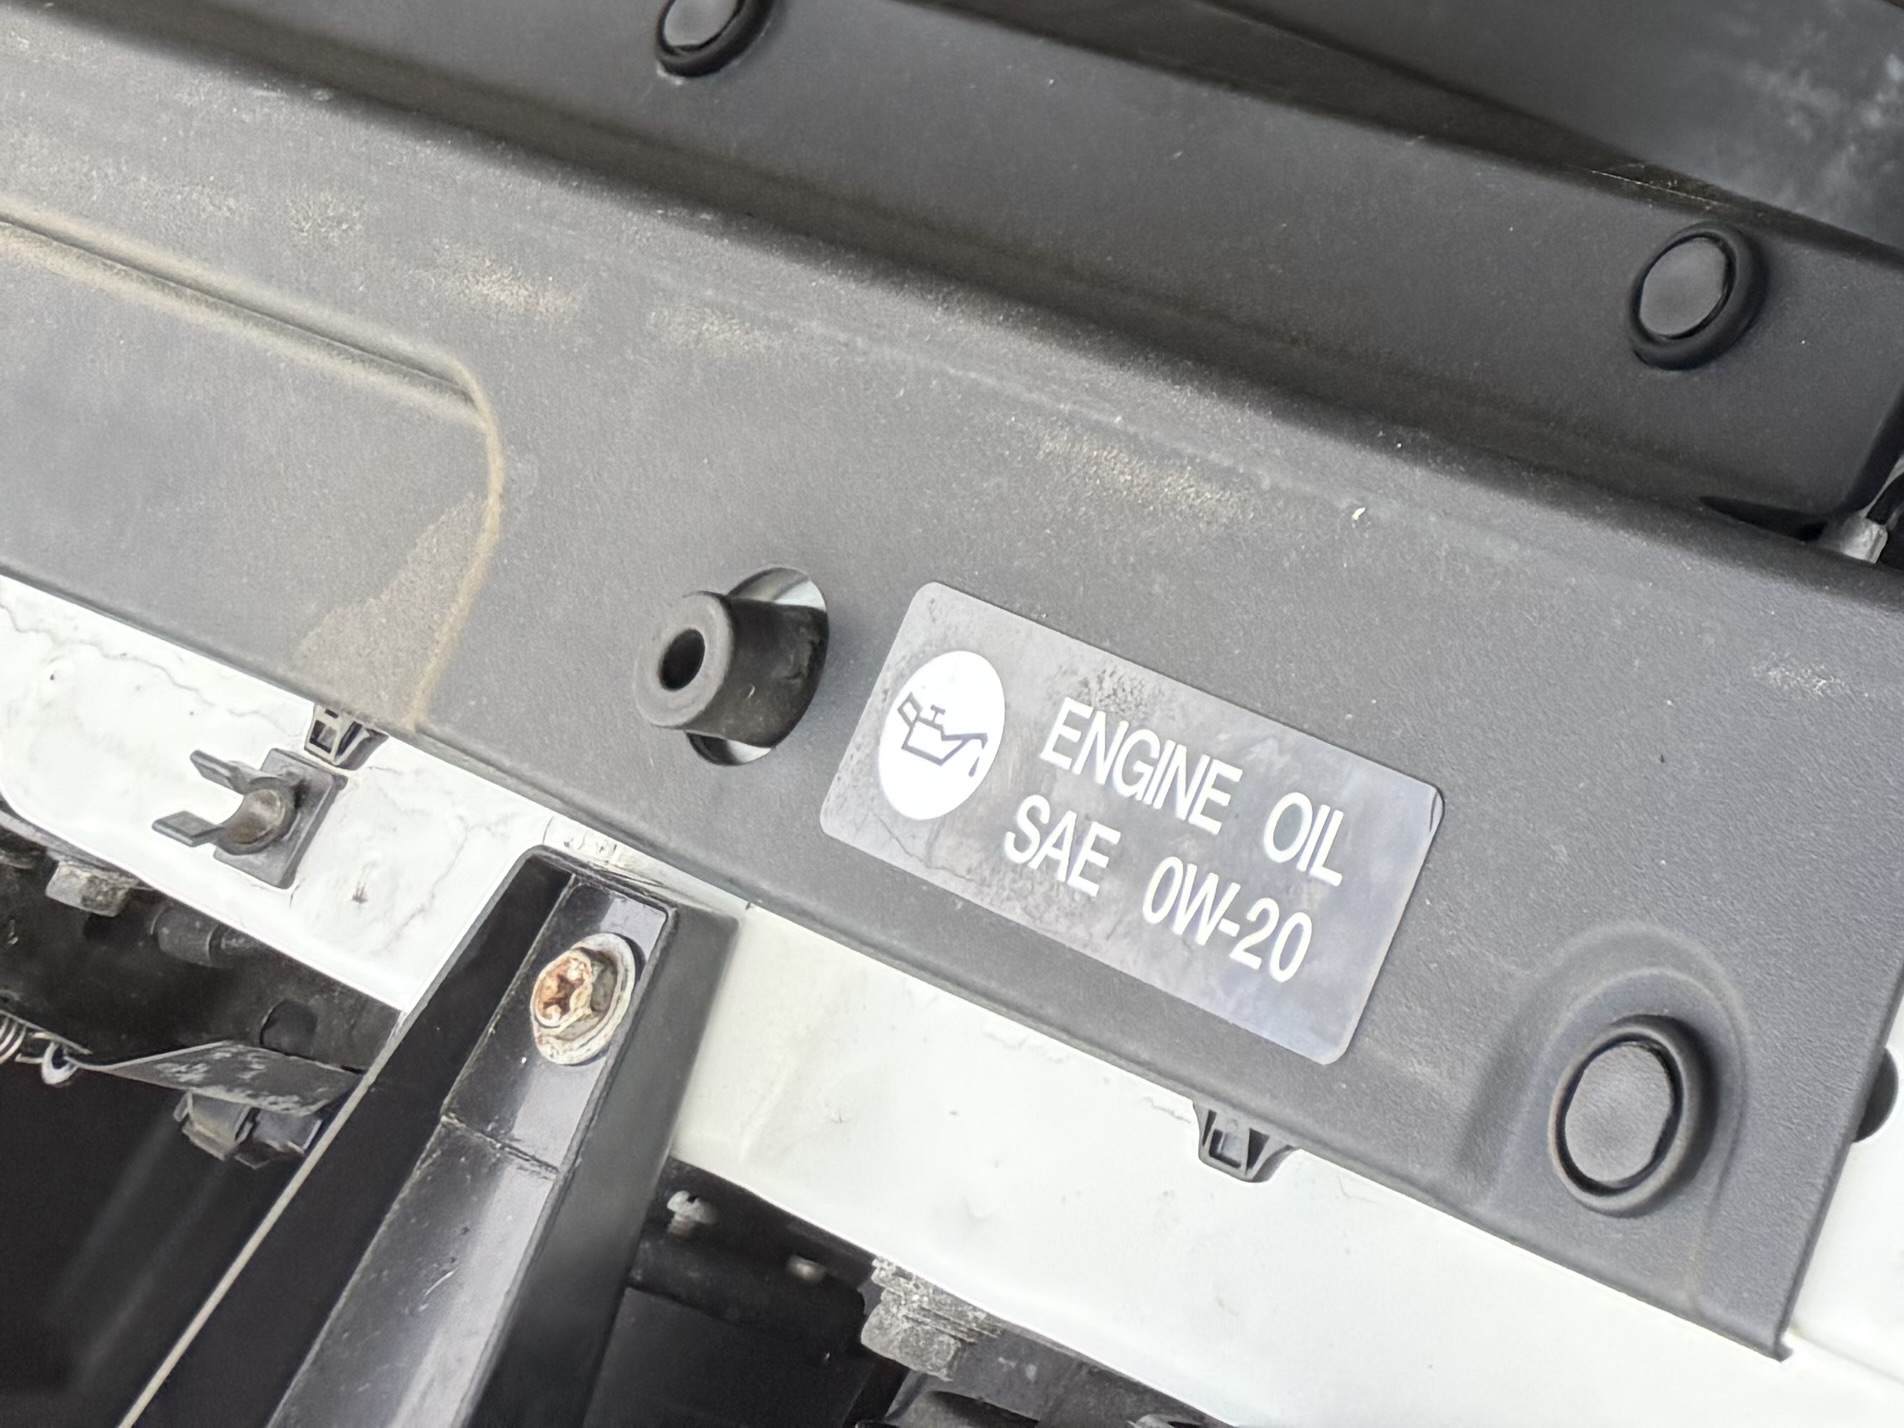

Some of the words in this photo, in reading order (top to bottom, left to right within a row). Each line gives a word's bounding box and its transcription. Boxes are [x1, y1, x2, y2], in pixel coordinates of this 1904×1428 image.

[1038, 696, 1244, 835] ENGINE
[1262, 792, 1344, 887] OIL
[1004, 794, 1121, 897] SAE
[1140, 856, 1313, 982] 0W-20
